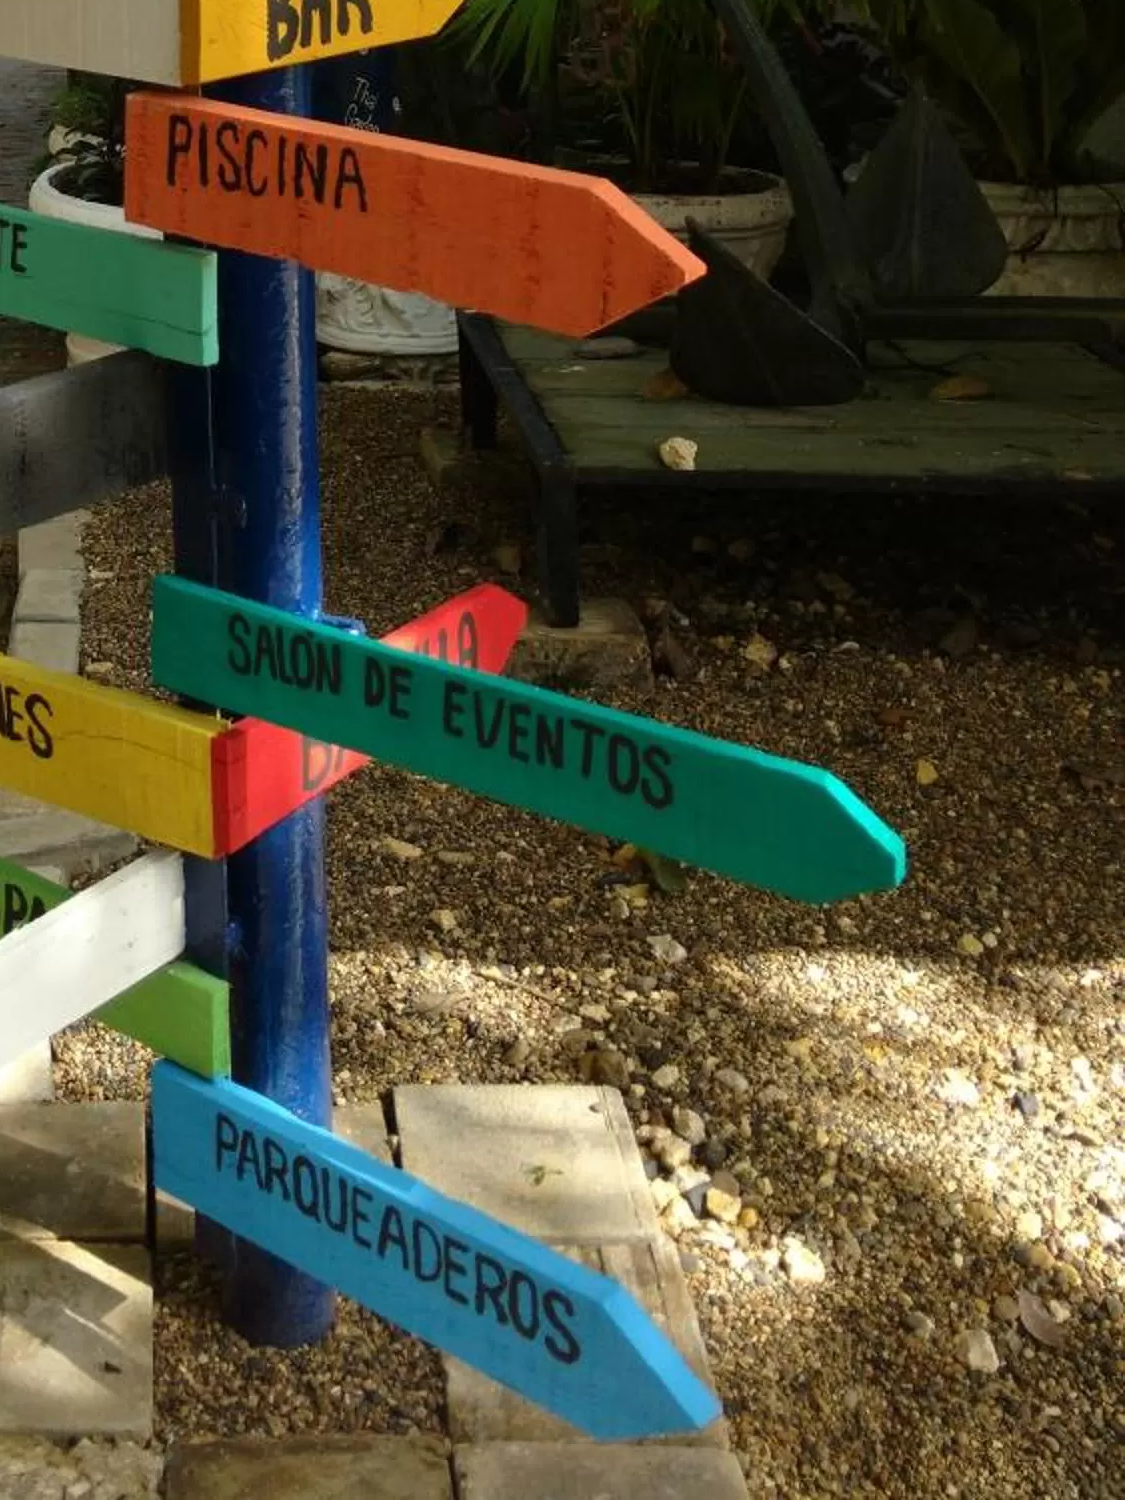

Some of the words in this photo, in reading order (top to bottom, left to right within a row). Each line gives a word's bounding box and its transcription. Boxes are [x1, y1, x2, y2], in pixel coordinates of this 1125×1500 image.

[165, 115, 368, 212] PISCINA
[363, 654, 410, 720] DE
[443, 681, 673, 809] EVENTOS
[215, 1113, 580, 1364] PARQUEADEROS
